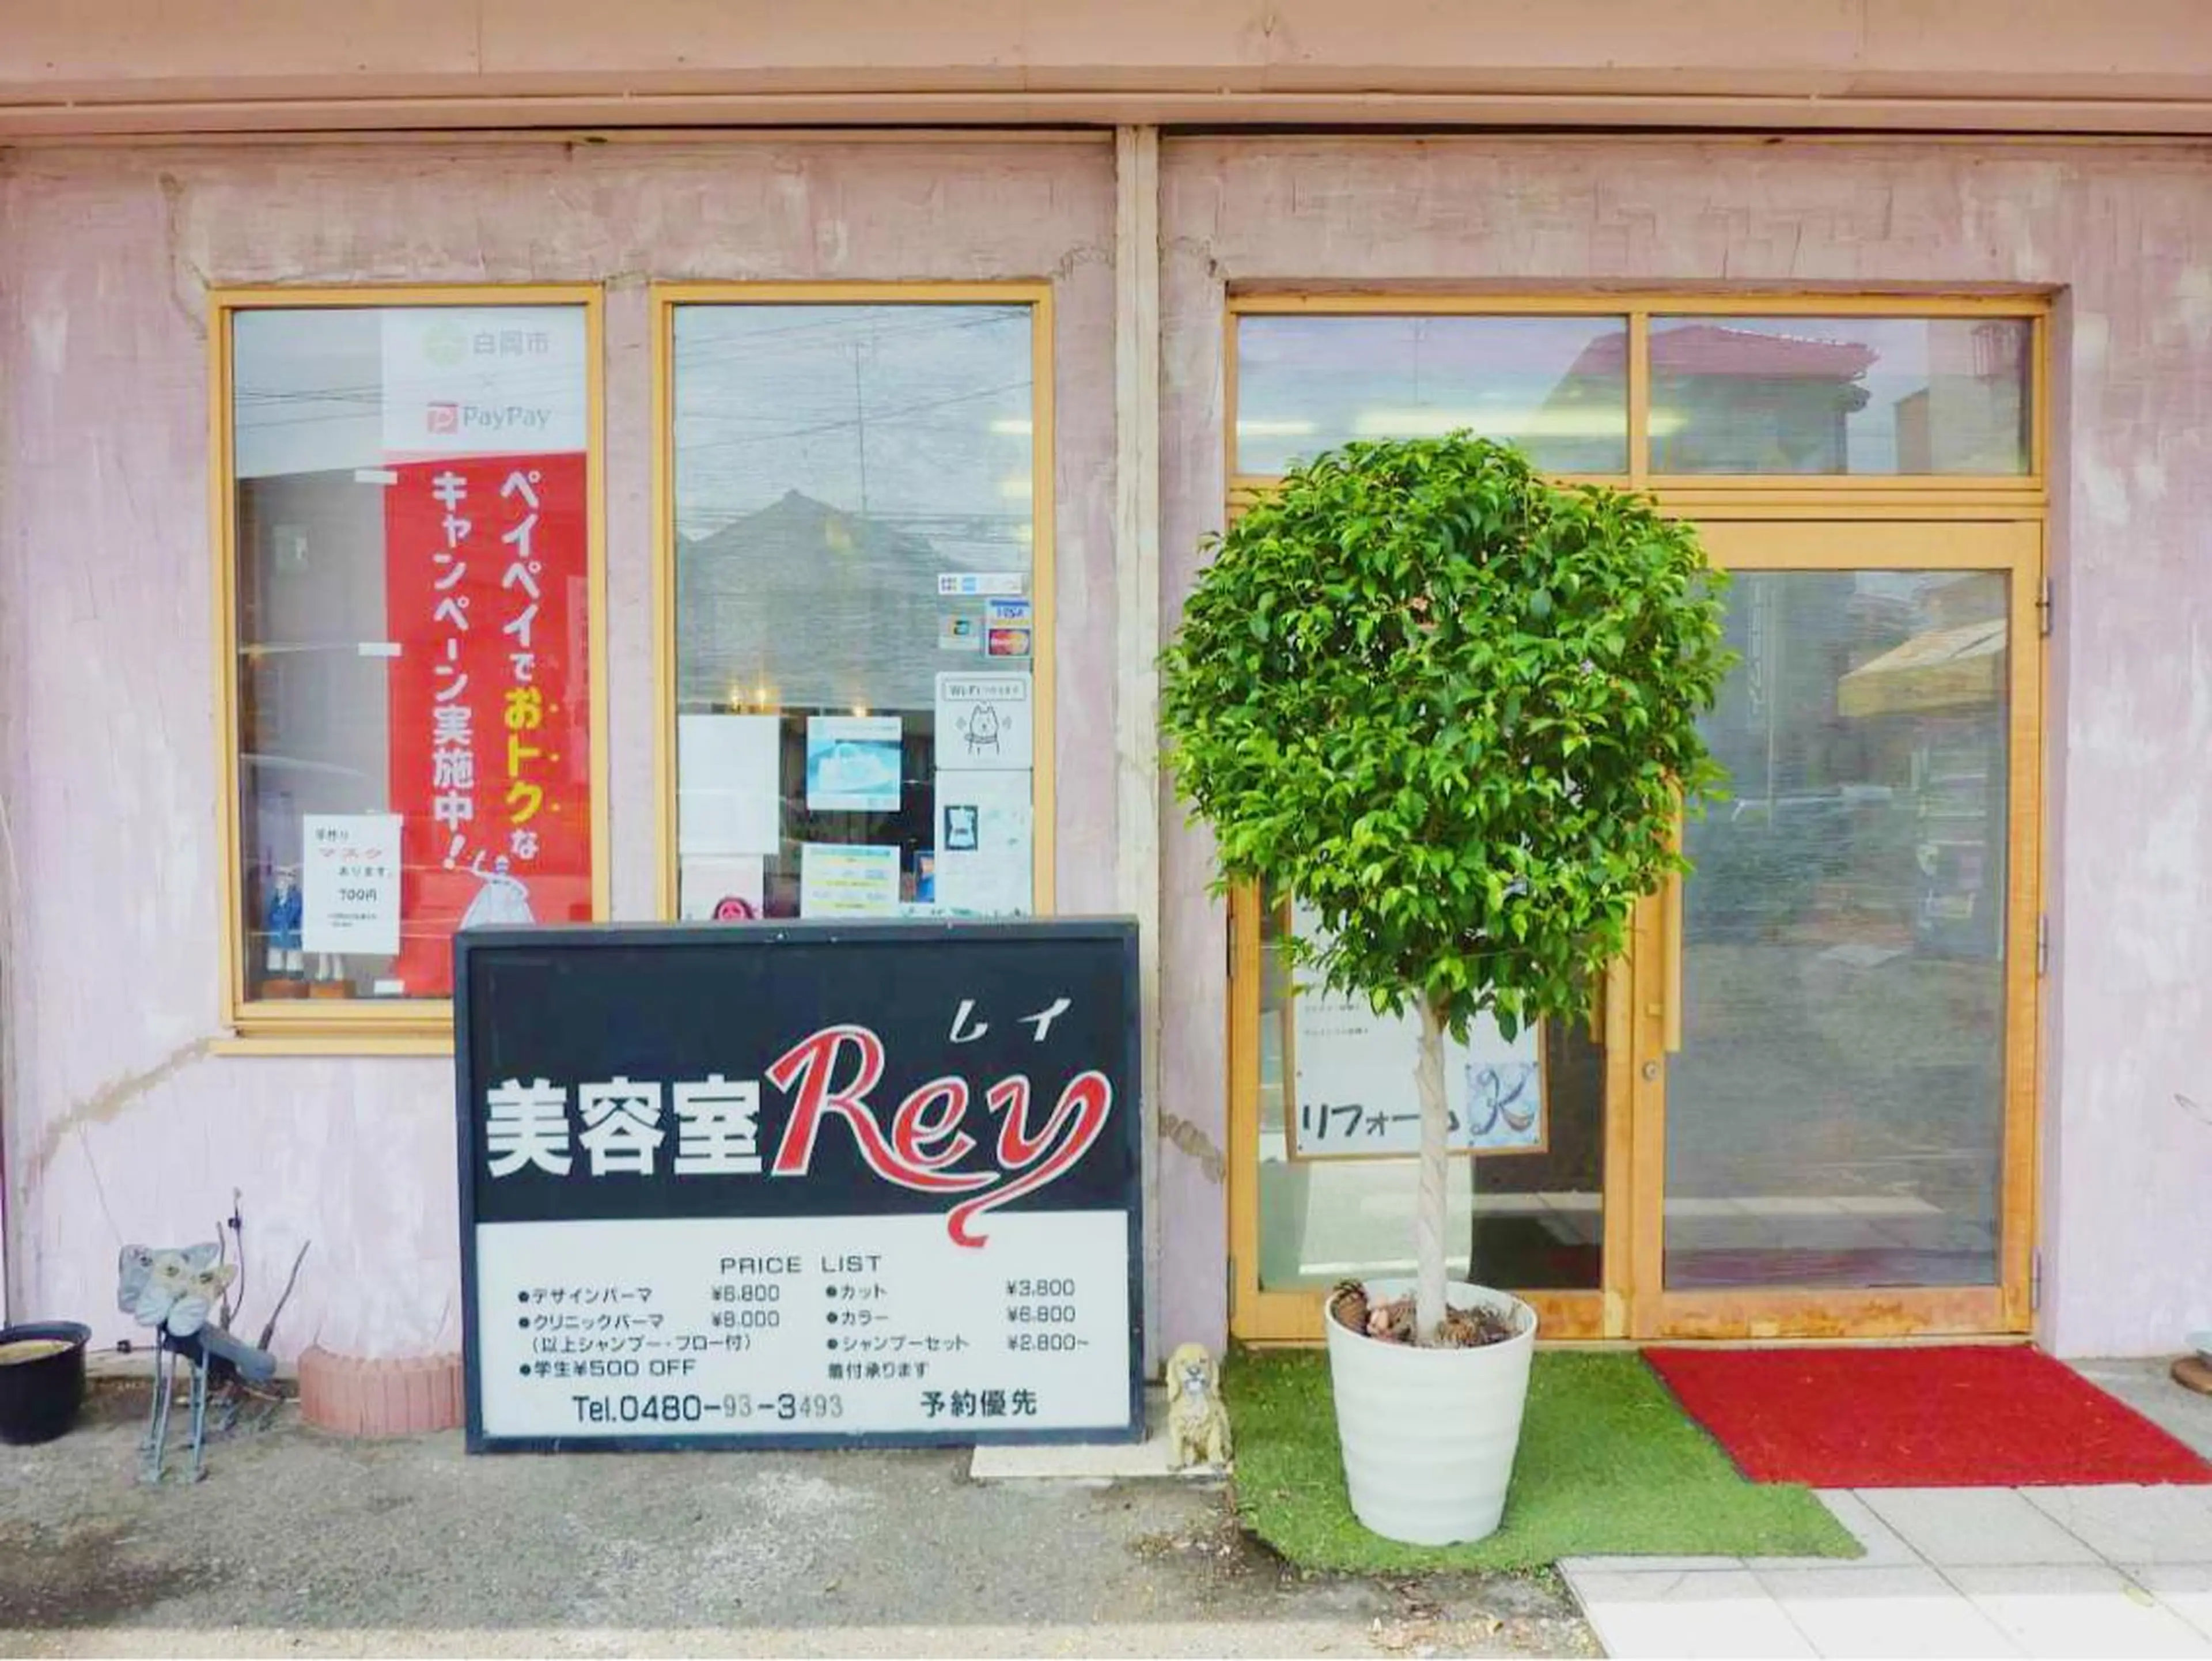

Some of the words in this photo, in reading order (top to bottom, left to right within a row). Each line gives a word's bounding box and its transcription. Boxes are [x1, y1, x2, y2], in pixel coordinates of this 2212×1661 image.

[464, 405, 551, 431] PayPay
[500, 469, 552, 860] ペイペイでおトクな
[949, 998, 1071, 1043] レイ
[487, 1074, 763, 1178] 美容室
[765, 1024, 1112, 1248] Rey
[721, 1257, 802, 1274] PRICE
[821, 1255, 882, 1273] LIST
[841, 1285, 888, 1300] カット
[842, 1309, 889, 1326] カラー
[650, 1359, 696, 1376] OFF
[920, 1388, 1037, 1418] 予約優先
